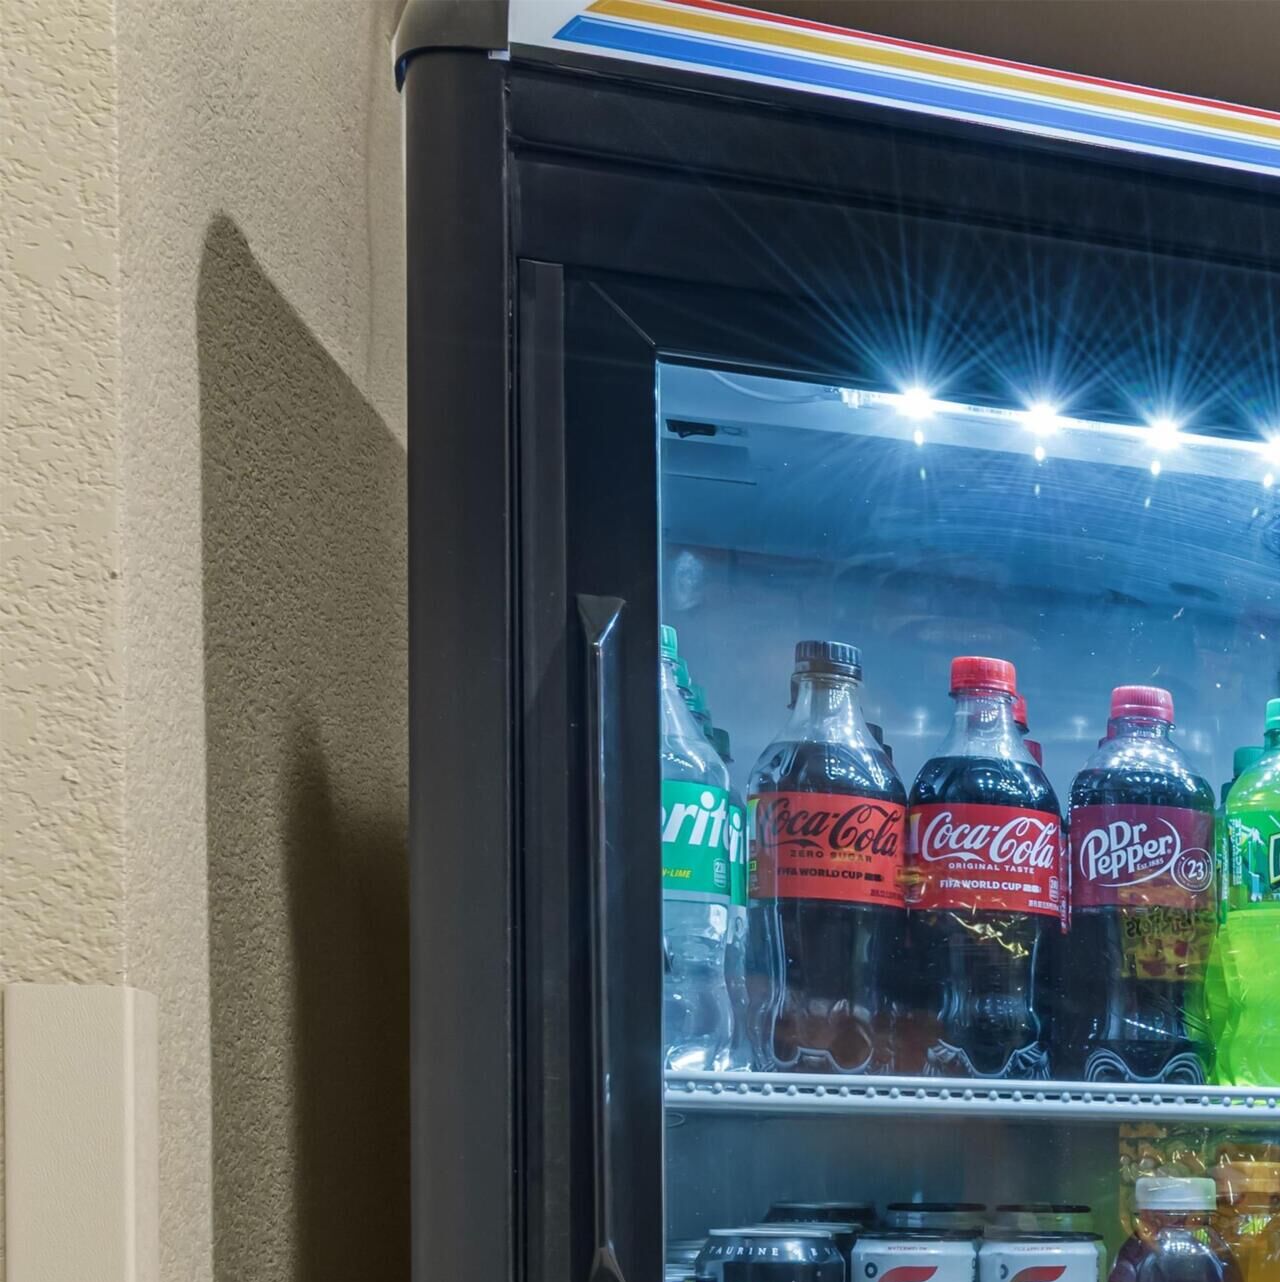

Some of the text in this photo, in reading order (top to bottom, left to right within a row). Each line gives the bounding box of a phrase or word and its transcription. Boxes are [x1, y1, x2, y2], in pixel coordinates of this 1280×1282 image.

[663, 790, 728, 849] rit
[763, 799, 902, 857] Coca-Cola
[922, 811, 1056, 869] Coca-Cola
[1109, 821, 1147, 850] Dr
[790, 849, 872, 863] ZERO SUGAR
[799, 867, 840, 878] WORLD
[841, 870, 863, 880] CUP
[948, 862, 1035, 874] ORIGINAL TASTE
[1187, 859, 1204, 880] 23
[940, 879, 960, 889] FIFA
[961, 880, 1000, 890] WORLD
[1001, 883, 1022, 892] CUP
[708, 1246, 779, 1257] TAURINE
